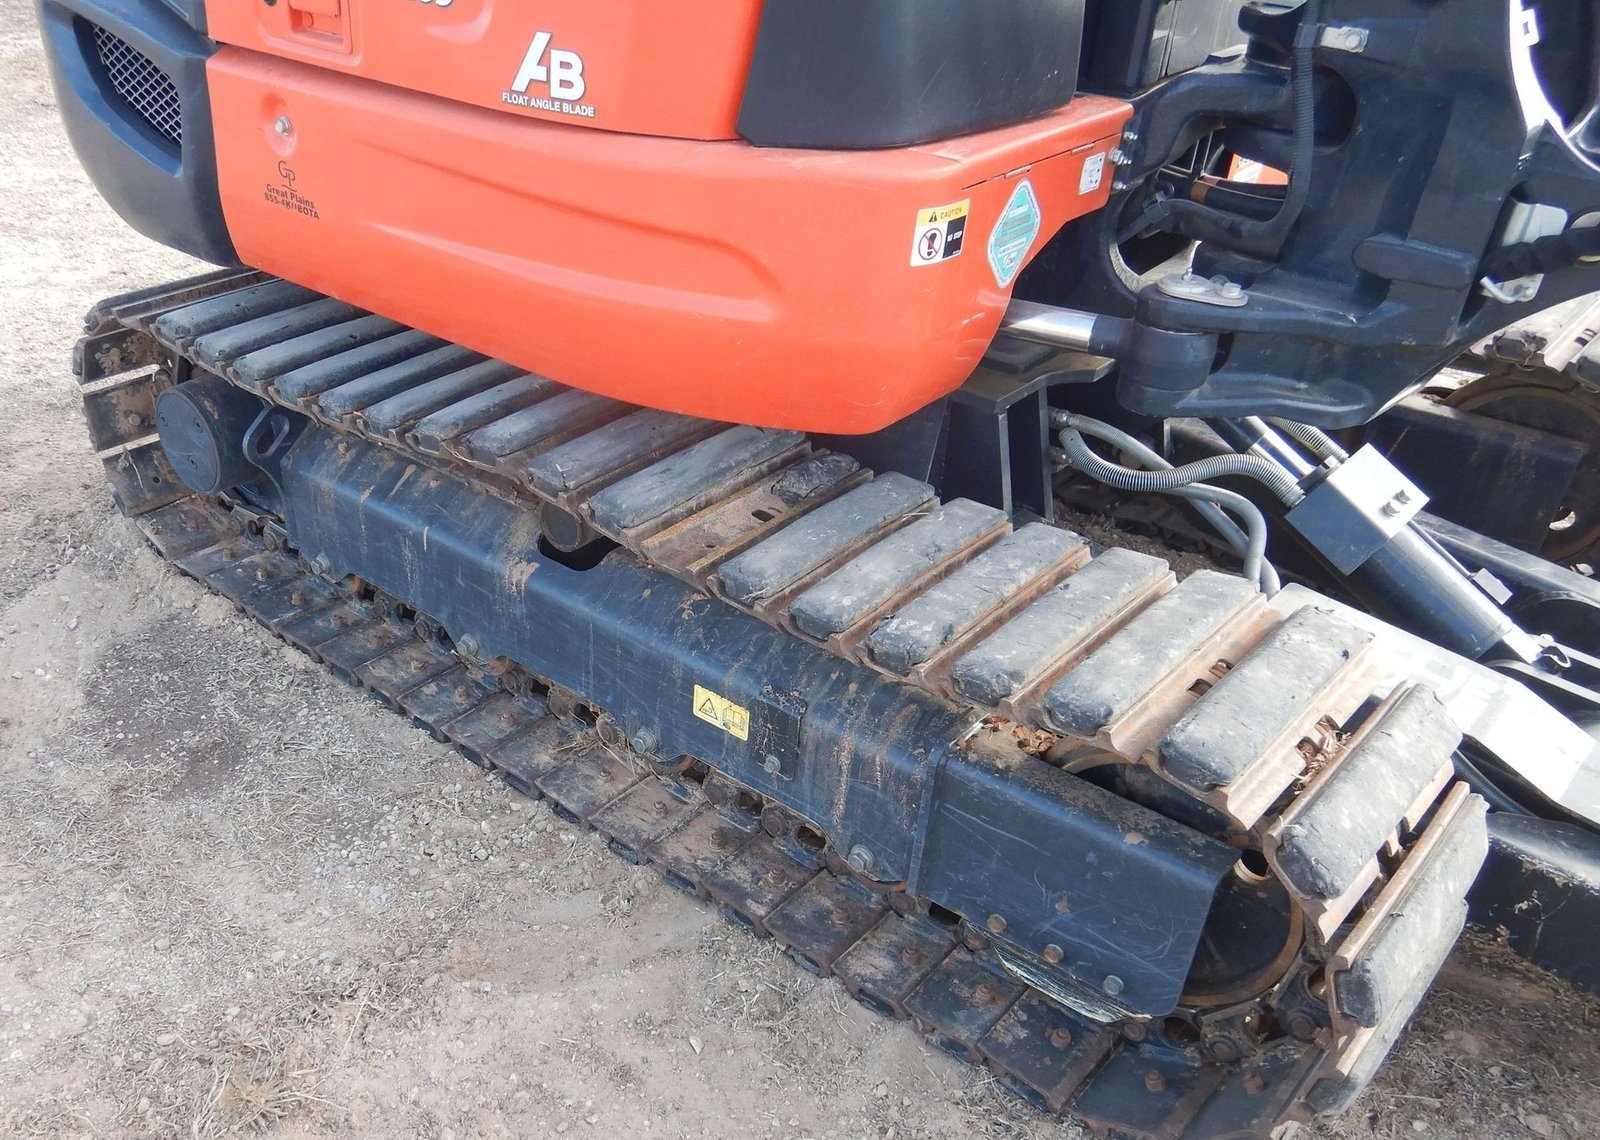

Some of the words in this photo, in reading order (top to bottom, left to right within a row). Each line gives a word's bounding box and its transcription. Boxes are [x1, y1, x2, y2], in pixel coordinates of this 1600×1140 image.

[502, 92, 529, 106] FLOAT
[530, 97, 560, 112] ANGLE
[562, 102, 595, 117] BLADE
[266, 183, 289, 199] Great
[290, 192, 315, 209] Plains
[940, 207, 963, 219] CAUTION
